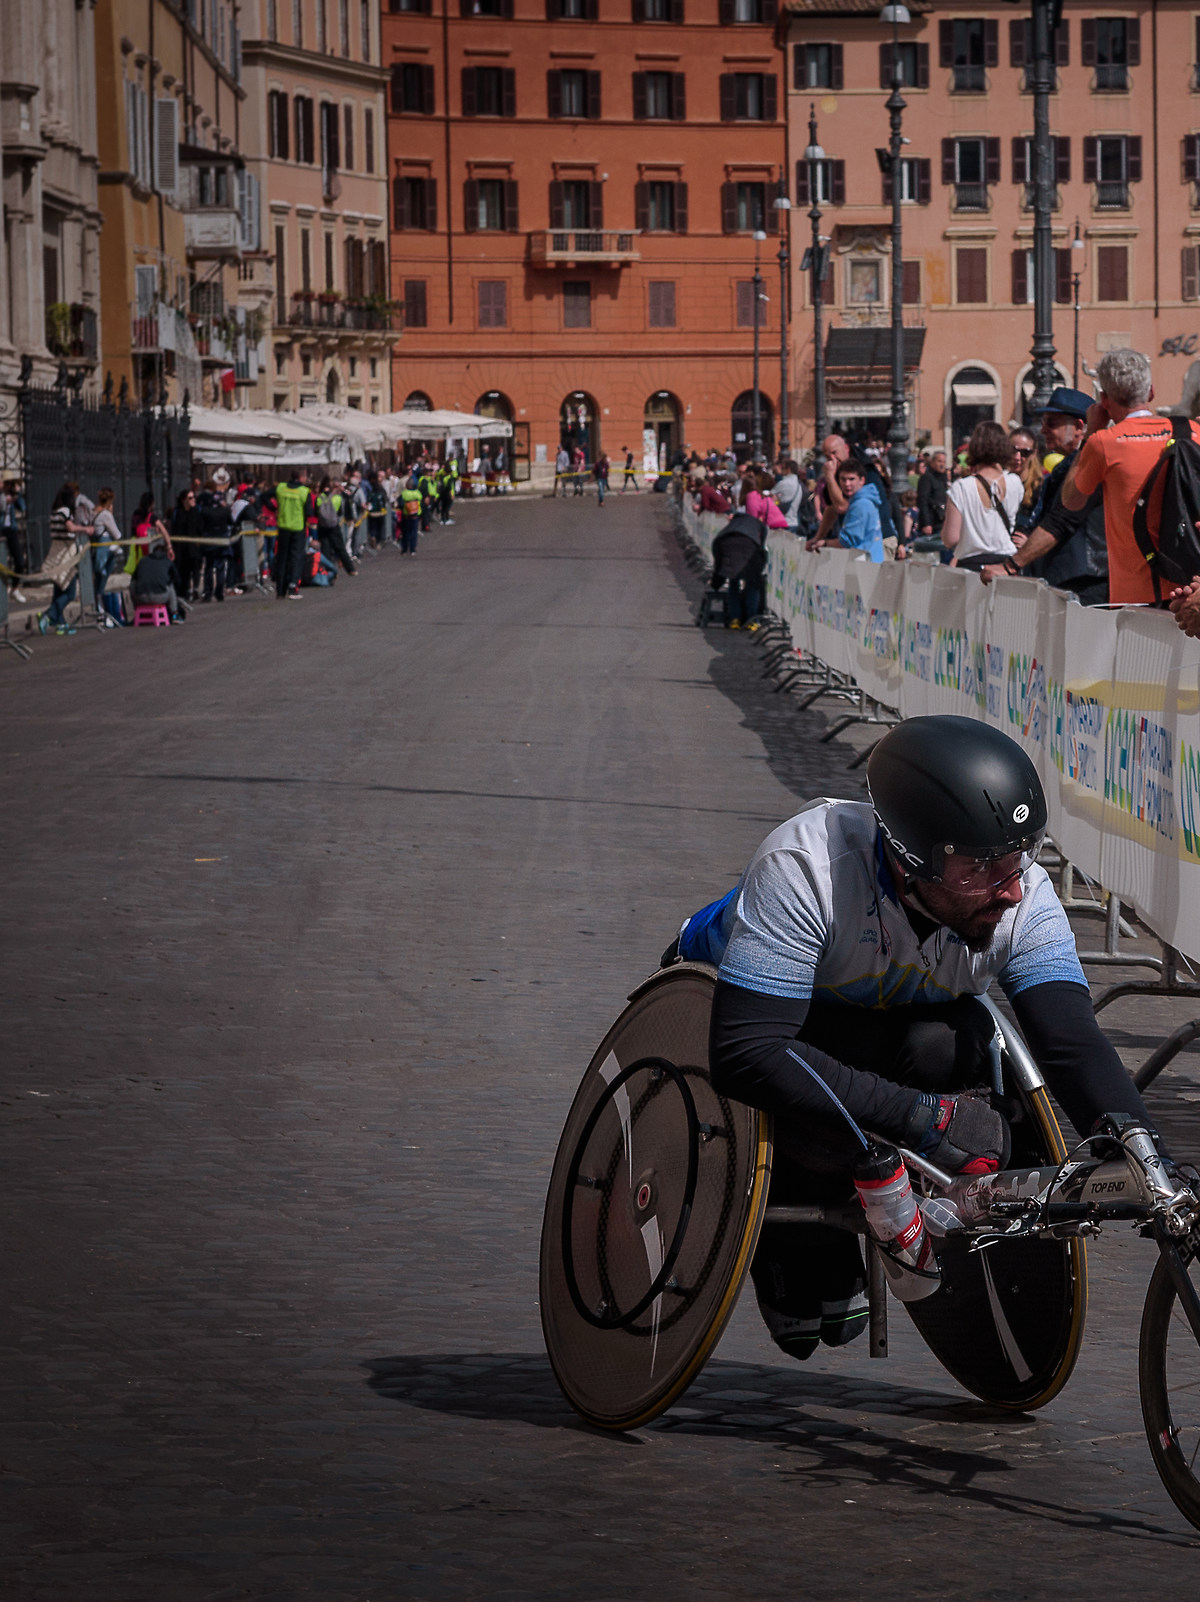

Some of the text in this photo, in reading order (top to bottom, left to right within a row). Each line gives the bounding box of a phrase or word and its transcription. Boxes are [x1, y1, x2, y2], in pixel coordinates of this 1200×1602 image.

[1104, 704, 1136, 815] acea
[1091, 1181, 1125, 1194] TOP END
